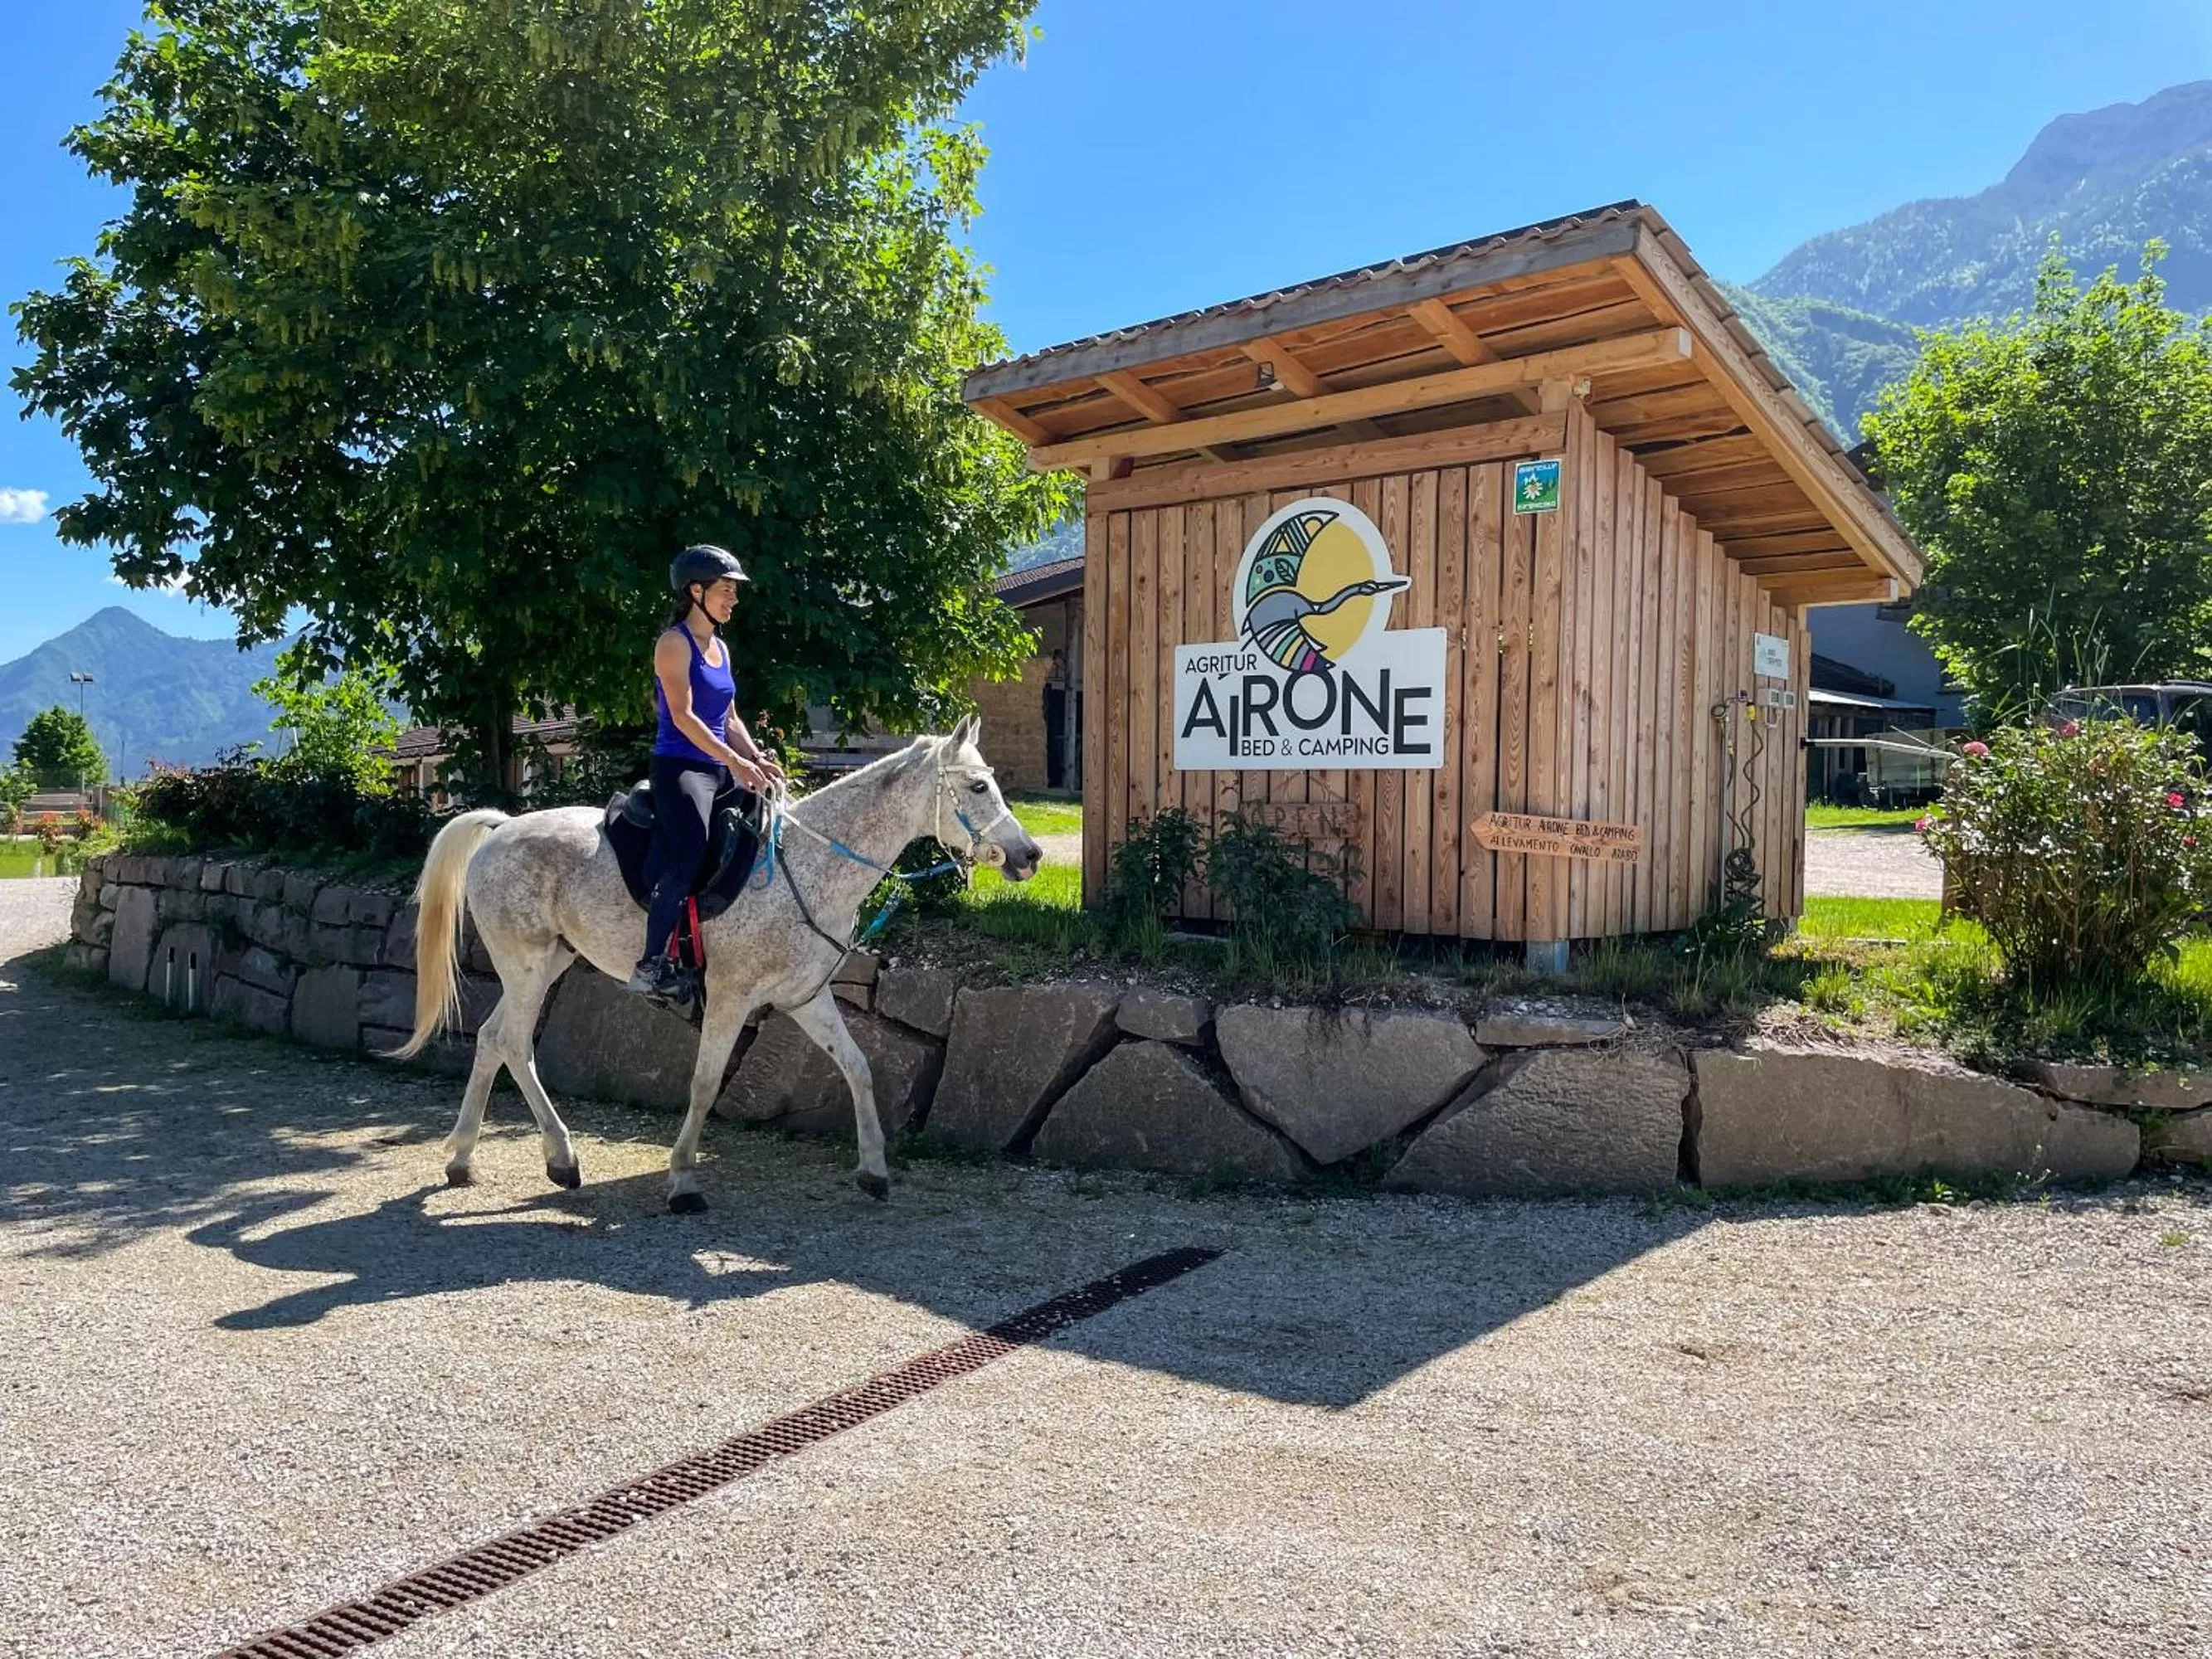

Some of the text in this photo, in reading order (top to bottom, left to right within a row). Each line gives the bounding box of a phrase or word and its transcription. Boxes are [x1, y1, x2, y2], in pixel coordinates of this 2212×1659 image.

[1185, 654, 1257, 674] AGRITUR
[1181, 669, 1432, 757] AIRONE
[1242, 737, 1389, 757] BED & CAMPING
[1490, 814, 1531, 830] AGRITUR
[1539, 818, 1569, 835] AIRONE
[1490, 835, 1559, 852] ALLEVAMENTO
